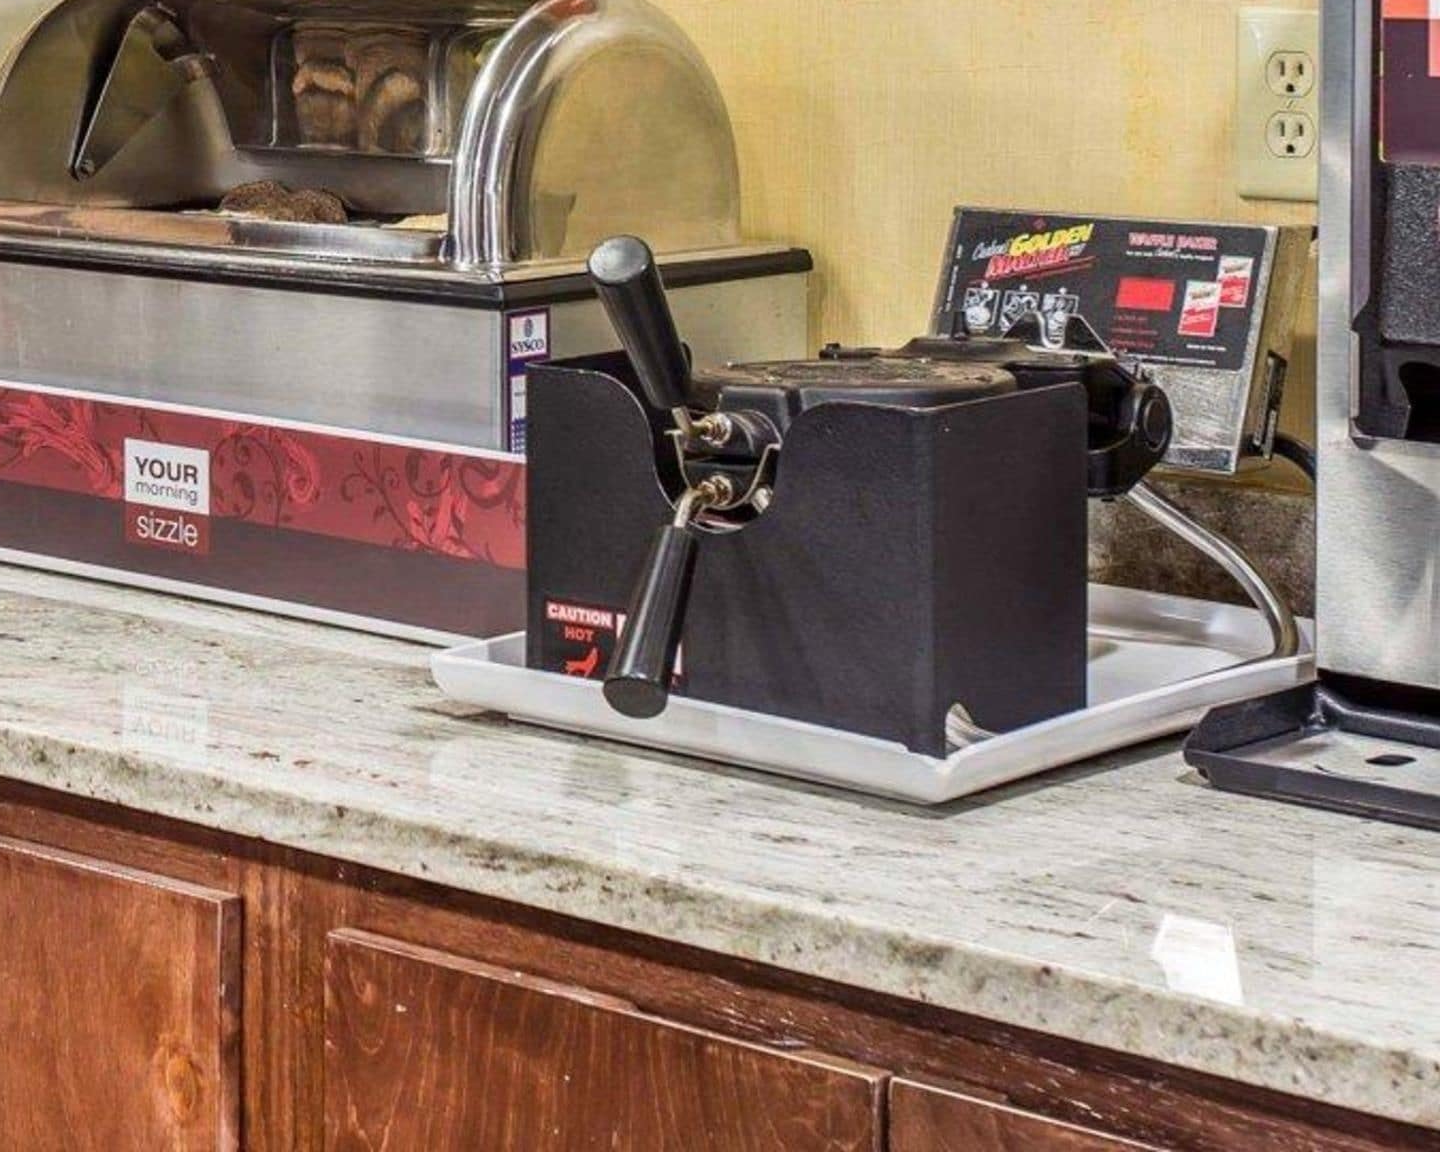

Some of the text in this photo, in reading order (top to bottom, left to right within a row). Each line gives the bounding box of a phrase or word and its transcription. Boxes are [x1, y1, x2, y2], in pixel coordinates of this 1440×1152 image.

[134, 456, 198, 484] YOUR
[135, 480, 198, 506] morning
[137, 511, 199, 546] sizzle
[547, 602, 613, 629] CAUTION
[564, 627, 594, 643] HOT
